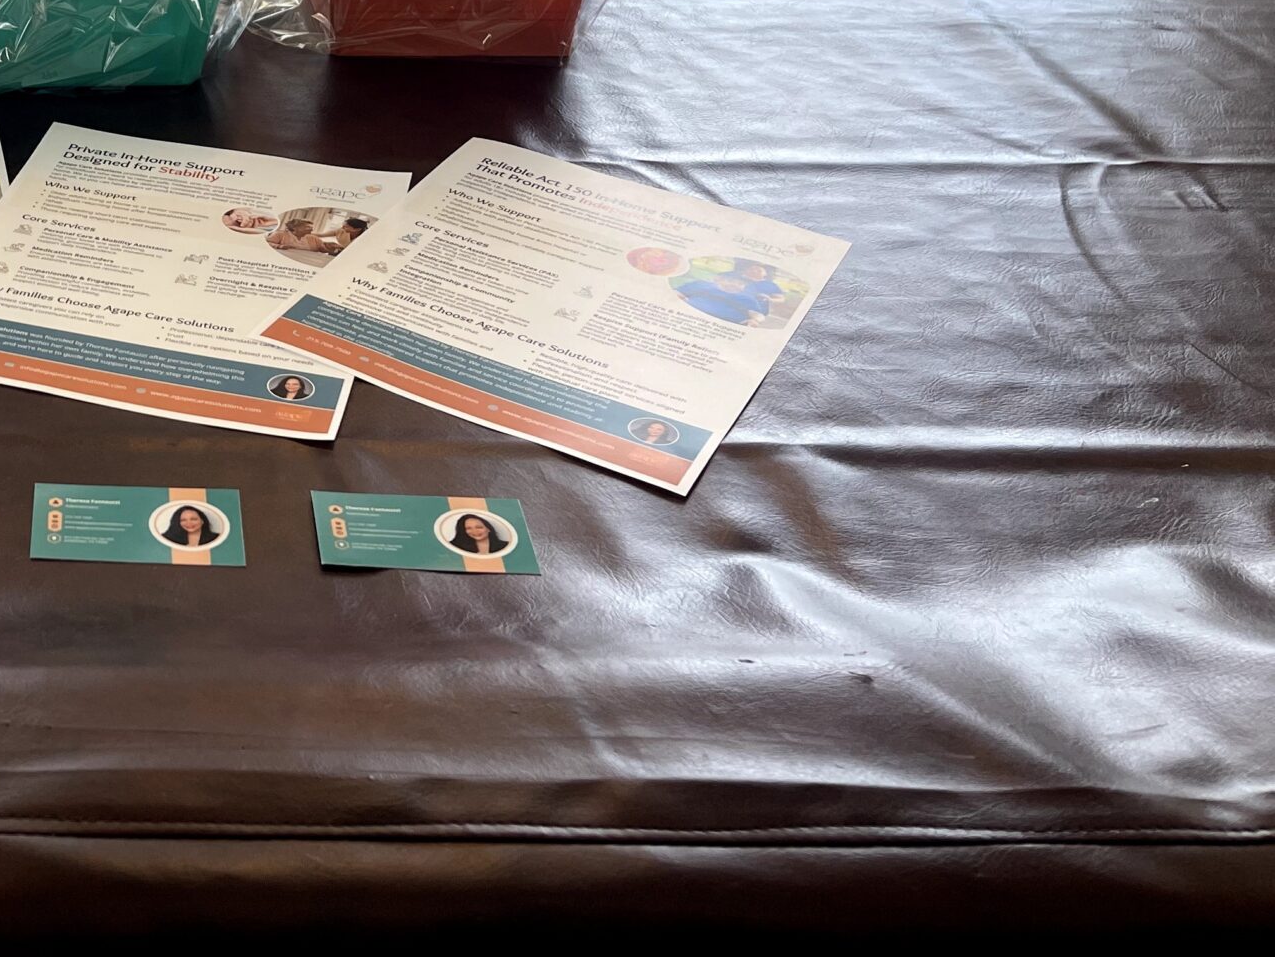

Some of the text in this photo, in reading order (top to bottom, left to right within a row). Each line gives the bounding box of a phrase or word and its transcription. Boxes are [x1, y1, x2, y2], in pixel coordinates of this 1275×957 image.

[62, 151, 219, 182] Designed for Stability
[67, 143, 243, 176] Private In-Home Support
[481, 157, 534, 177] Reliable
[535, 174, 560, 187] Act
[564, 183, 592, 196] 150
[44, 180, 136, 201] Who We Support
[476, 163, 505, 177] That
[507, 173, 574, 200] Promotes
[448, 187, 540, 222] Who We Support
[21, 213, 95, 232] Core Services
[414, 220, 489, 248] Core Services
[5, 287, 53, 301] Families
[56, 296, 101, 309] Choose
[103, 304, 141, 317] Agape
[144, 312, 173, 322] Care
[176, 317, 234, 332] Solutions
[351, 276, 608, 368] Why Families Choose Agape Care Solutions
